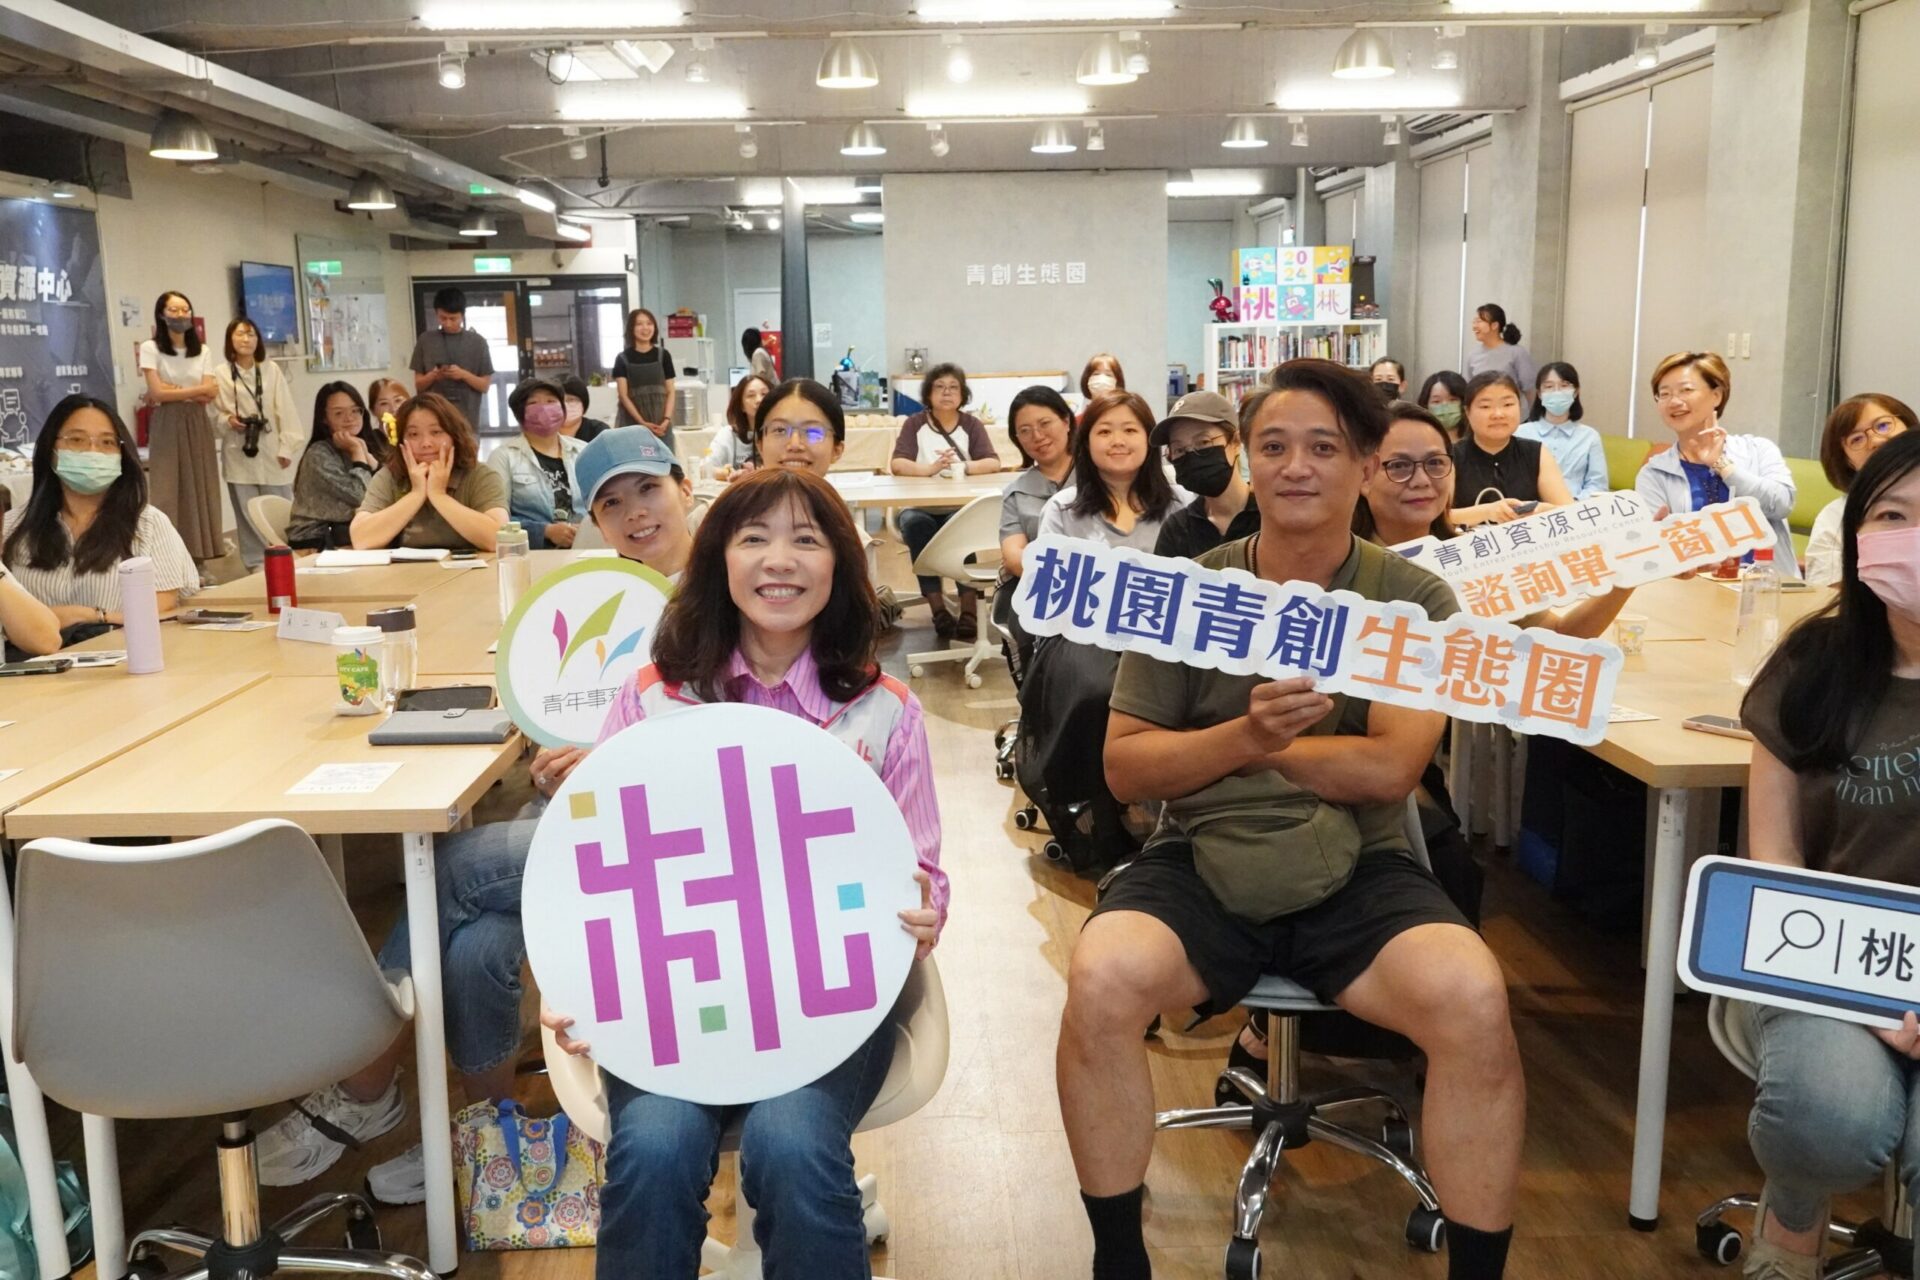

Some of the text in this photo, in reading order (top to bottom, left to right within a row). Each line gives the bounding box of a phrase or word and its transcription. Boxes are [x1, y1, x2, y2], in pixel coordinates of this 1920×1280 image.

[966, 262, 1086, 285] 青創生態圈
[1433, 494, 1640, 570] 青創資源中心
[1460, 503, 1767, 618] 諮詢單一窗口
[1025, 546, 1605, 730] 桃園青創生態圈
[1858, 928, 1915, 983] 桃
